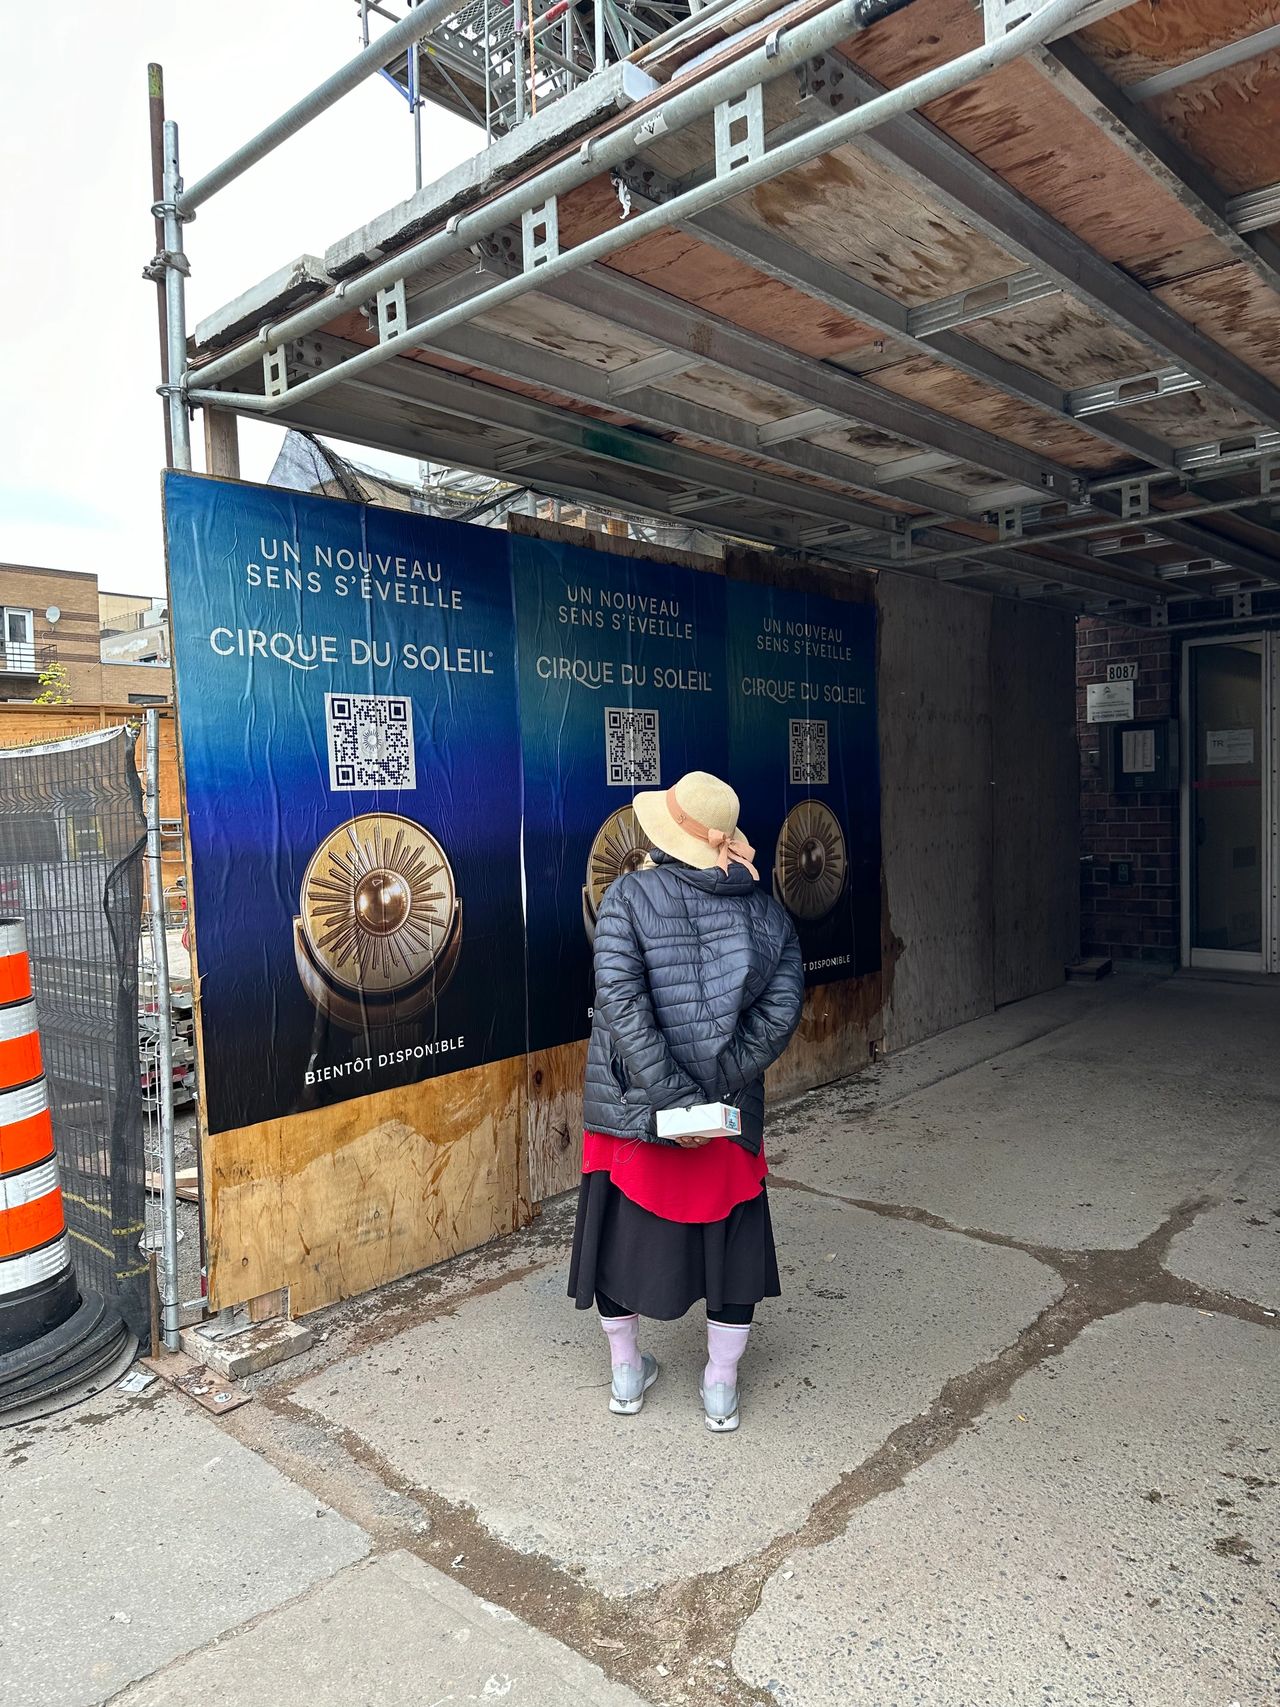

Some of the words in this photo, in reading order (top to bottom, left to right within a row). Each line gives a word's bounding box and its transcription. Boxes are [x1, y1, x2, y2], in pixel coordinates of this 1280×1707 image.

[260, 537, 301, 563] UN
[315, 545, 441, 582] NOUVEAU
[246, 563, 322, 593] SENS
[335, 573, 463, 610] S'ÉVEILLE
[567, 584, 592, 605] UN
[600, 590, 679, 618] NOUVEAU
[558, 605, 604, 629] SENS
[611, 611, 693, 640] S'ÉVEILLE
[763, 617, 782, 634] UN
[786, 620, 842, 643] NOUVEAU
[210, 627, 338, 671] CIRQUE
[350, 639, 391, 667] DU
[403, 643, 494, 674] SOLEIL
[757, 635, 790, 653] SENS
[794, 638, 852, 661] S'ÉVEILLE
[536, 656, 614, 689] CIRQUE
[621, 664, 646, 686] DU
[653, 667, 712, 692] SOLEIL
[1109, 664, 1136, 680] 8087
[741, 677, 797, 704] CIRQUE
[801, 682, 819, 700] DU
[823, 684, 866, 704] SOLEIL
[808, 954, 851, 971] DISPONIBLE
[305, 1057, 373, 1085] BIENTÔT
[378, 1036, 465, 1067] DISPONIBLE
